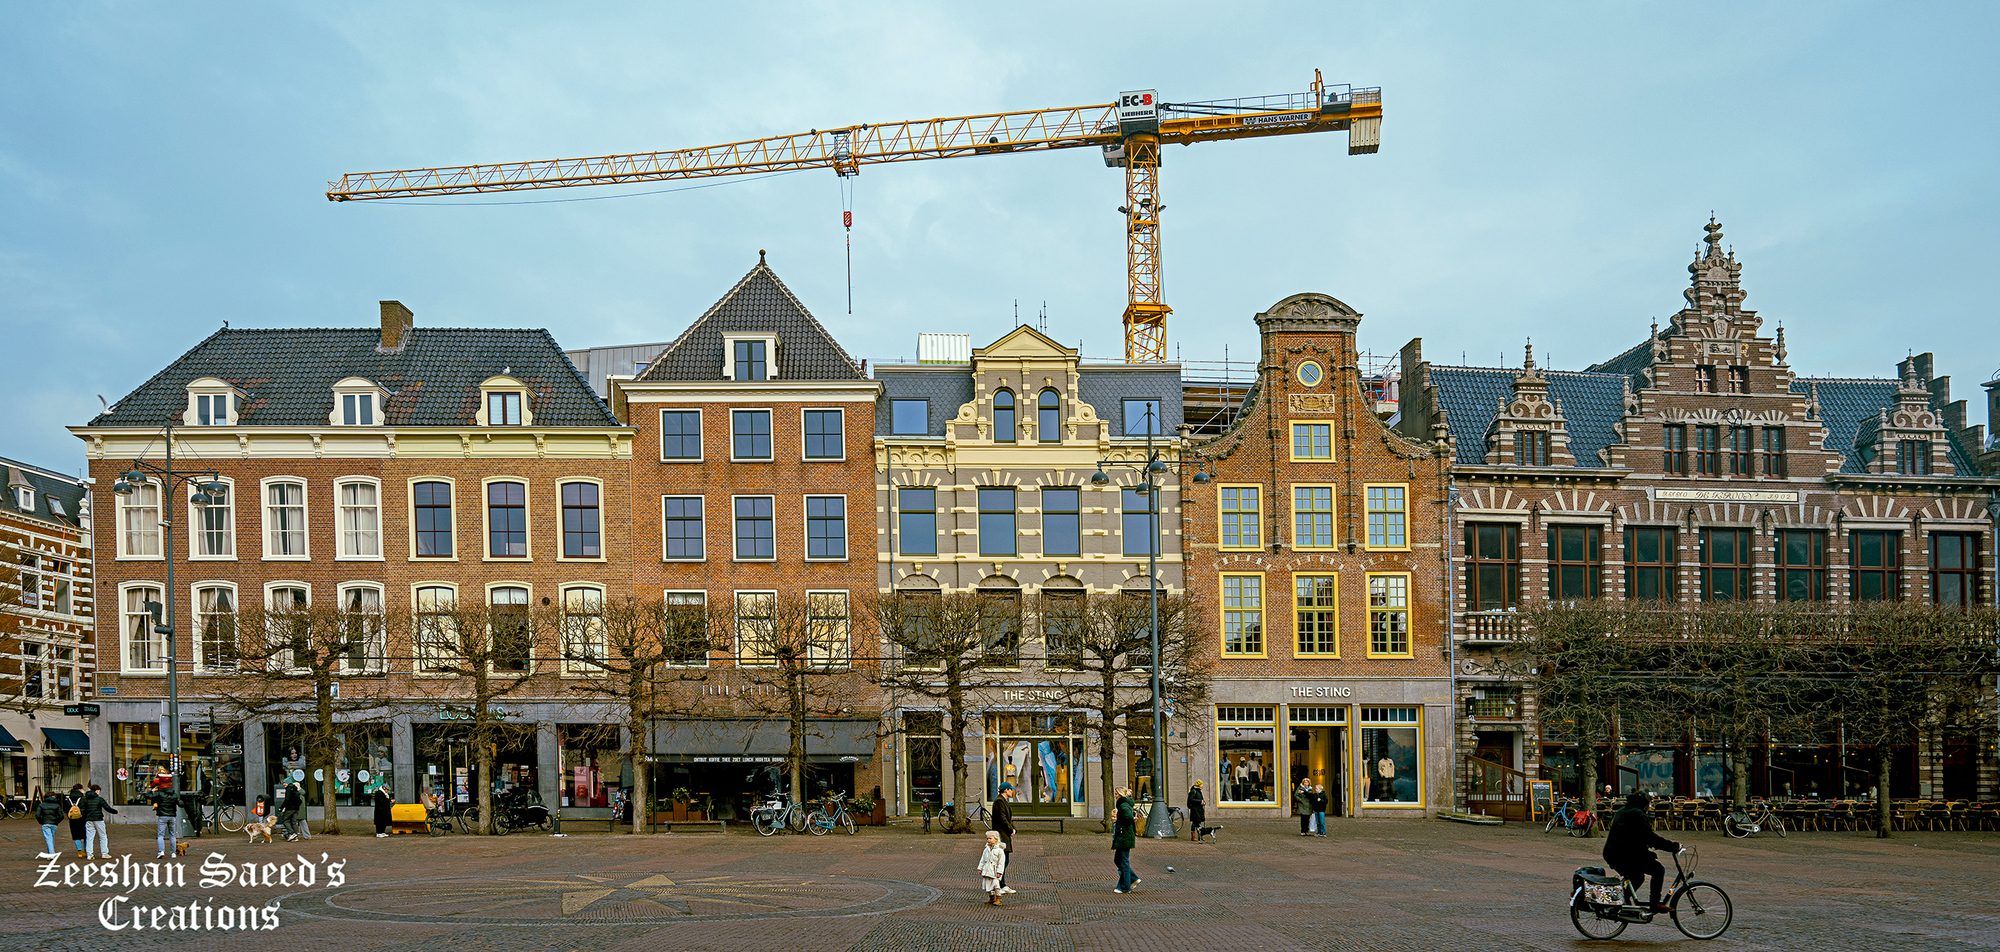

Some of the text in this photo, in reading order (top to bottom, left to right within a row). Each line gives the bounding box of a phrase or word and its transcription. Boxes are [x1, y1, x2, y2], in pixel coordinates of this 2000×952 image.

[1122, 93, 1153, 107] EC-B
[1258, 113, 1308, 123] HANS WARNER
[1003, 690, 1063, 701] THE STING
[1291, 687, 1351, 697] THE STING
